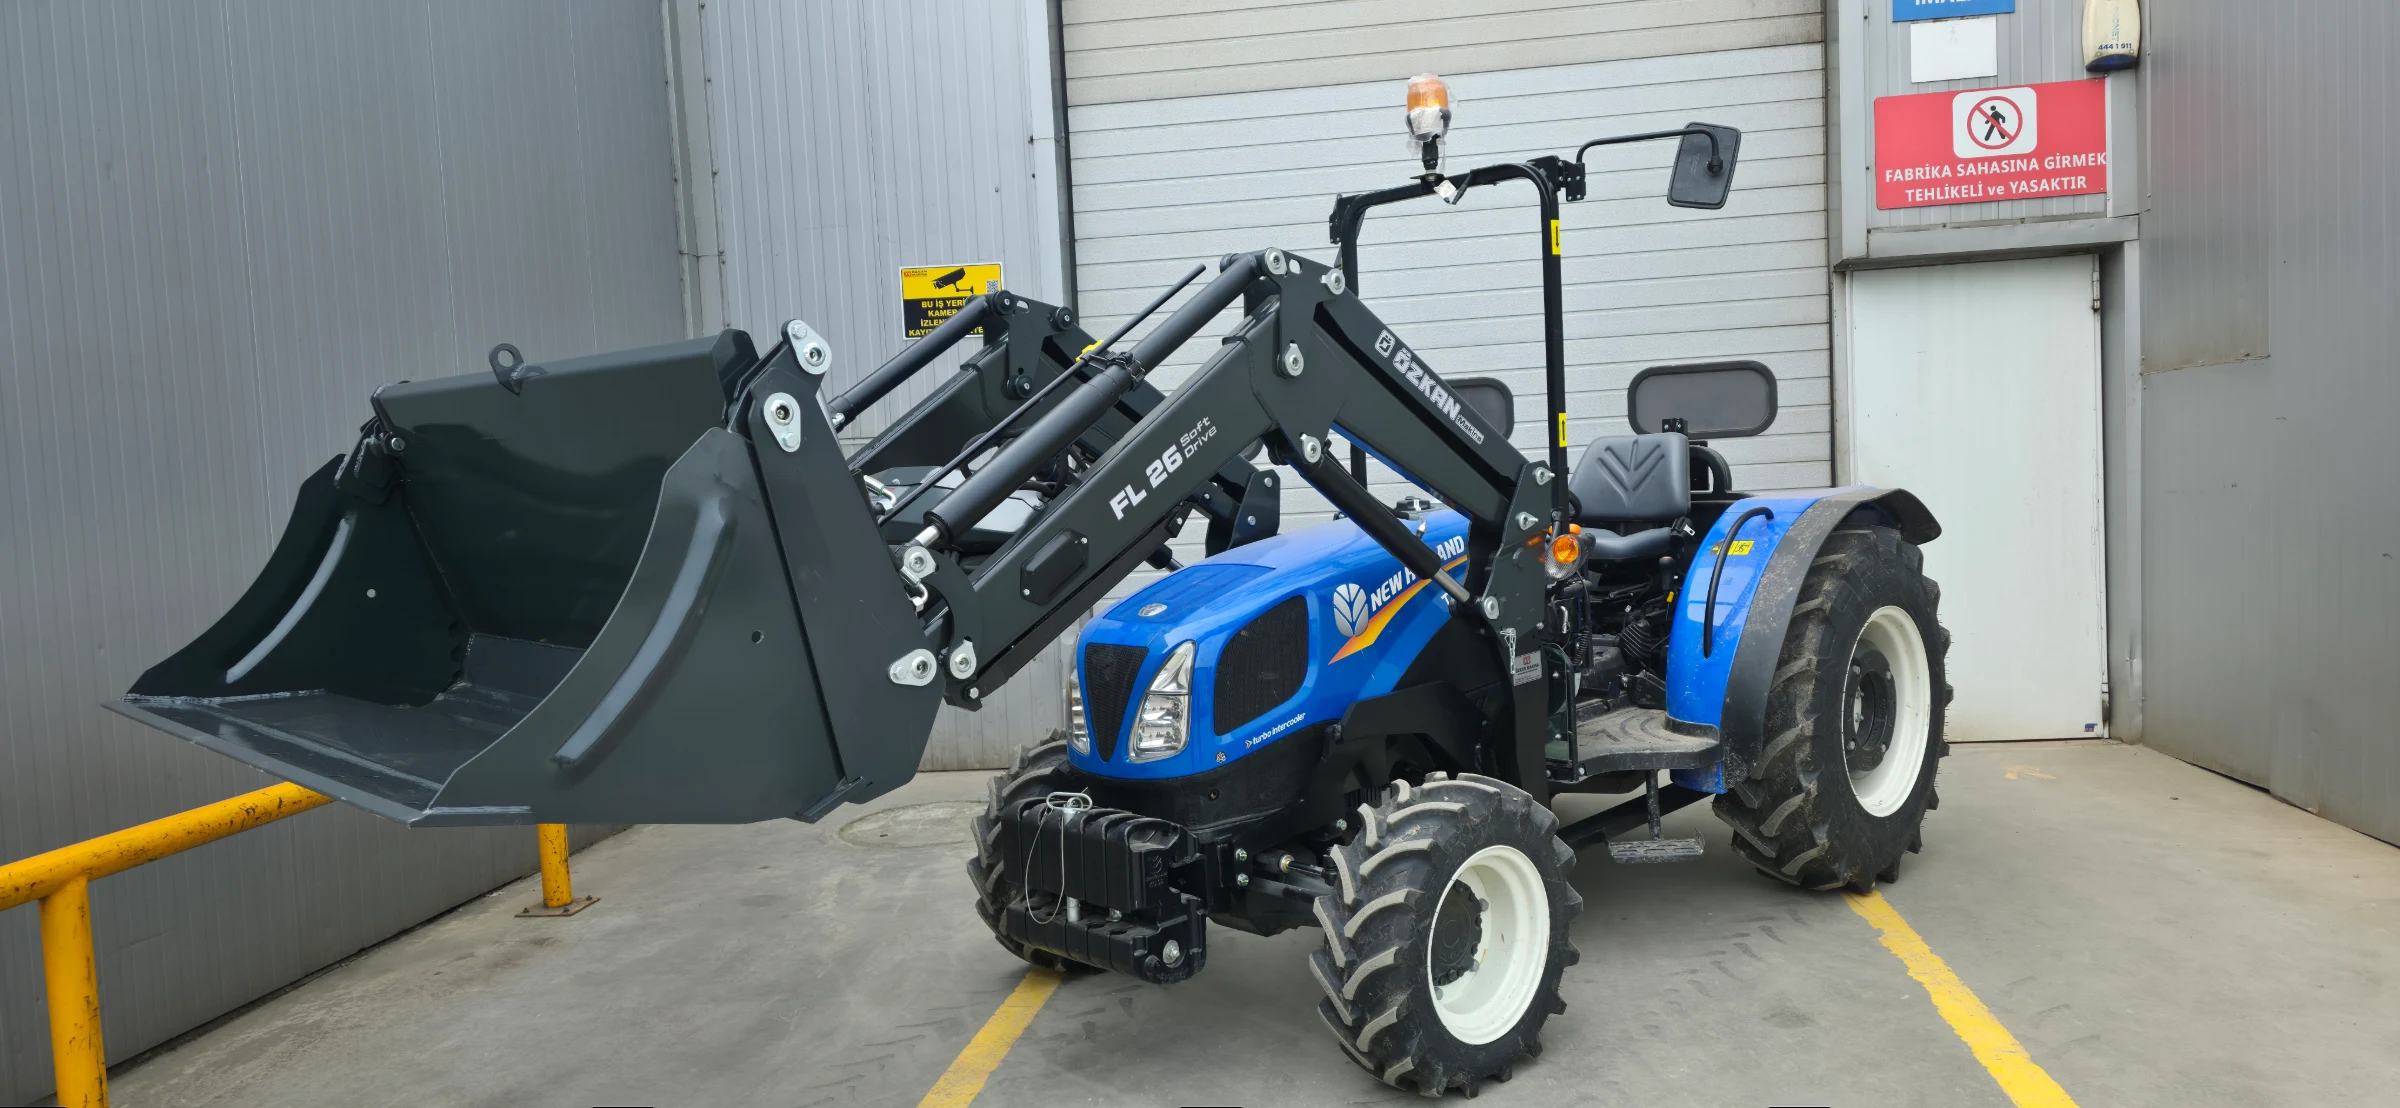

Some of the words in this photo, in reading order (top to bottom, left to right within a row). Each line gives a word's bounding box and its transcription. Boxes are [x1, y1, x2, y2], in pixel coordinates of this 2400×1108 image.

[1885, 162, 1952, 183] FABRİKA
[1956, 157, 2040, 178] SAHASINA
[2044, 151, 2107, 170] GİRMEK
[1905, 183, 1983, 202] TEHLİKELİ
[1987, 185, 2005, 196] ve
[2009, 175, 2087, 195] YASAKTIR
[921, 300, 933, 308] BU
[935, 298, 944, 308] İŞ
[927, 308, 959, 318] KAMER
[1393, 347, 1461, 420] ÖZKAN
[1180, 416, 1211, 447] Soft
[1184, 426, 1217, 459] Drive
[1109, 484, 1147, 520] FL
[1145, 444, 1183, 489] 26
[1370, 570, 1403, 612] NEW
[1404, 535, 1465, 585] HAND
[1252, 730, 1271, 745] turbo
[1272, 712, 1306, 735] intercooler
